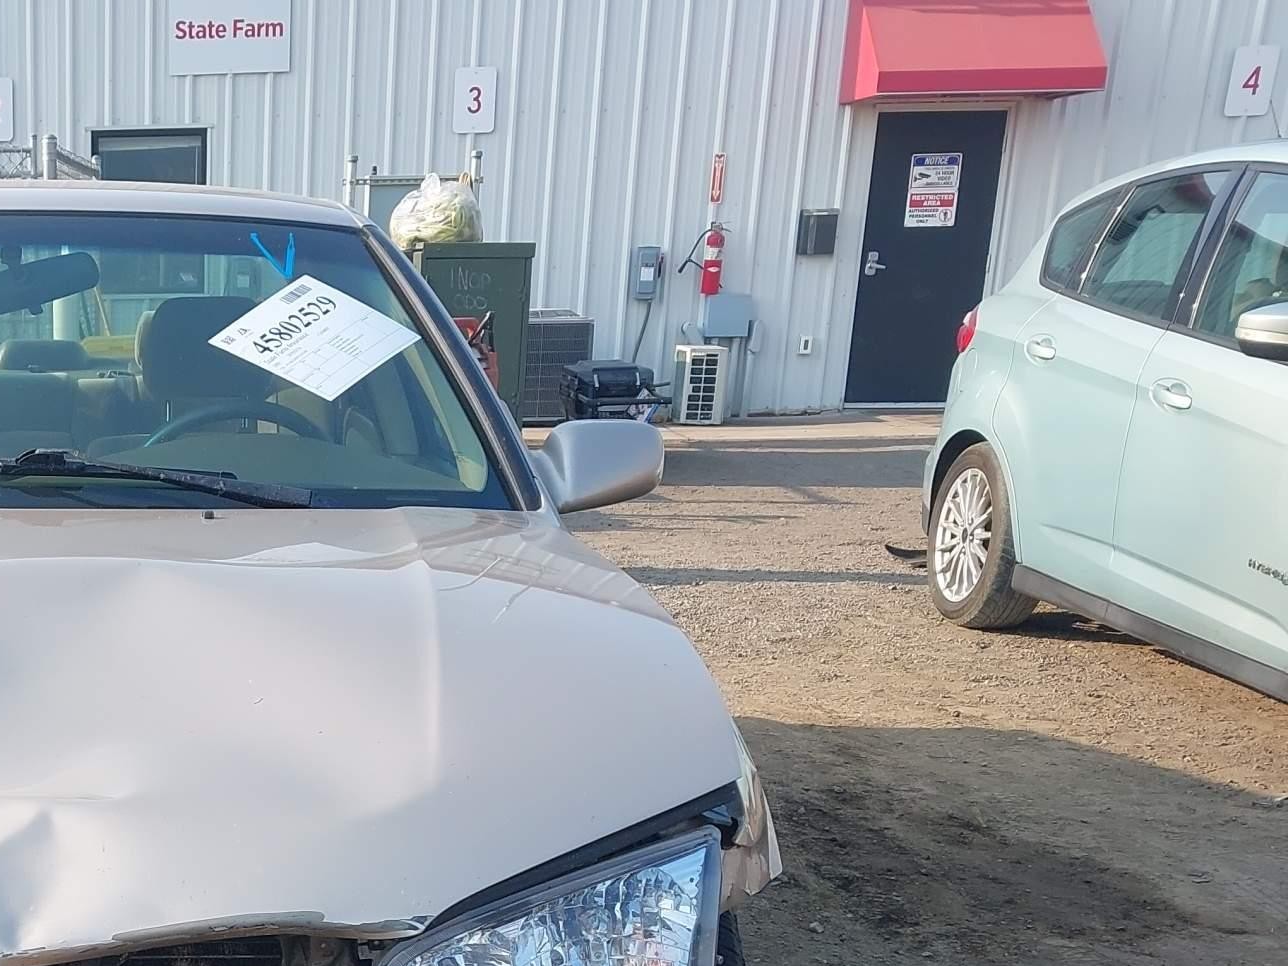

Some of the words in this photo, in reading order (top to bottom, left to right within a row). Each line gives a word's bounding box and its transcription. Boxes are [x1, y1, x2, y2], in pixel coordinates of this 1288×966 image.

[175, 20, 227, 40] State
[232, 18, 284, 39] Farm
[1242, 65, 1261, 95] 4
[467, 86, 482, 114] 3
[924, 157, 949, 165] NOTICE
[252, 296, 337, 354] 45802529
